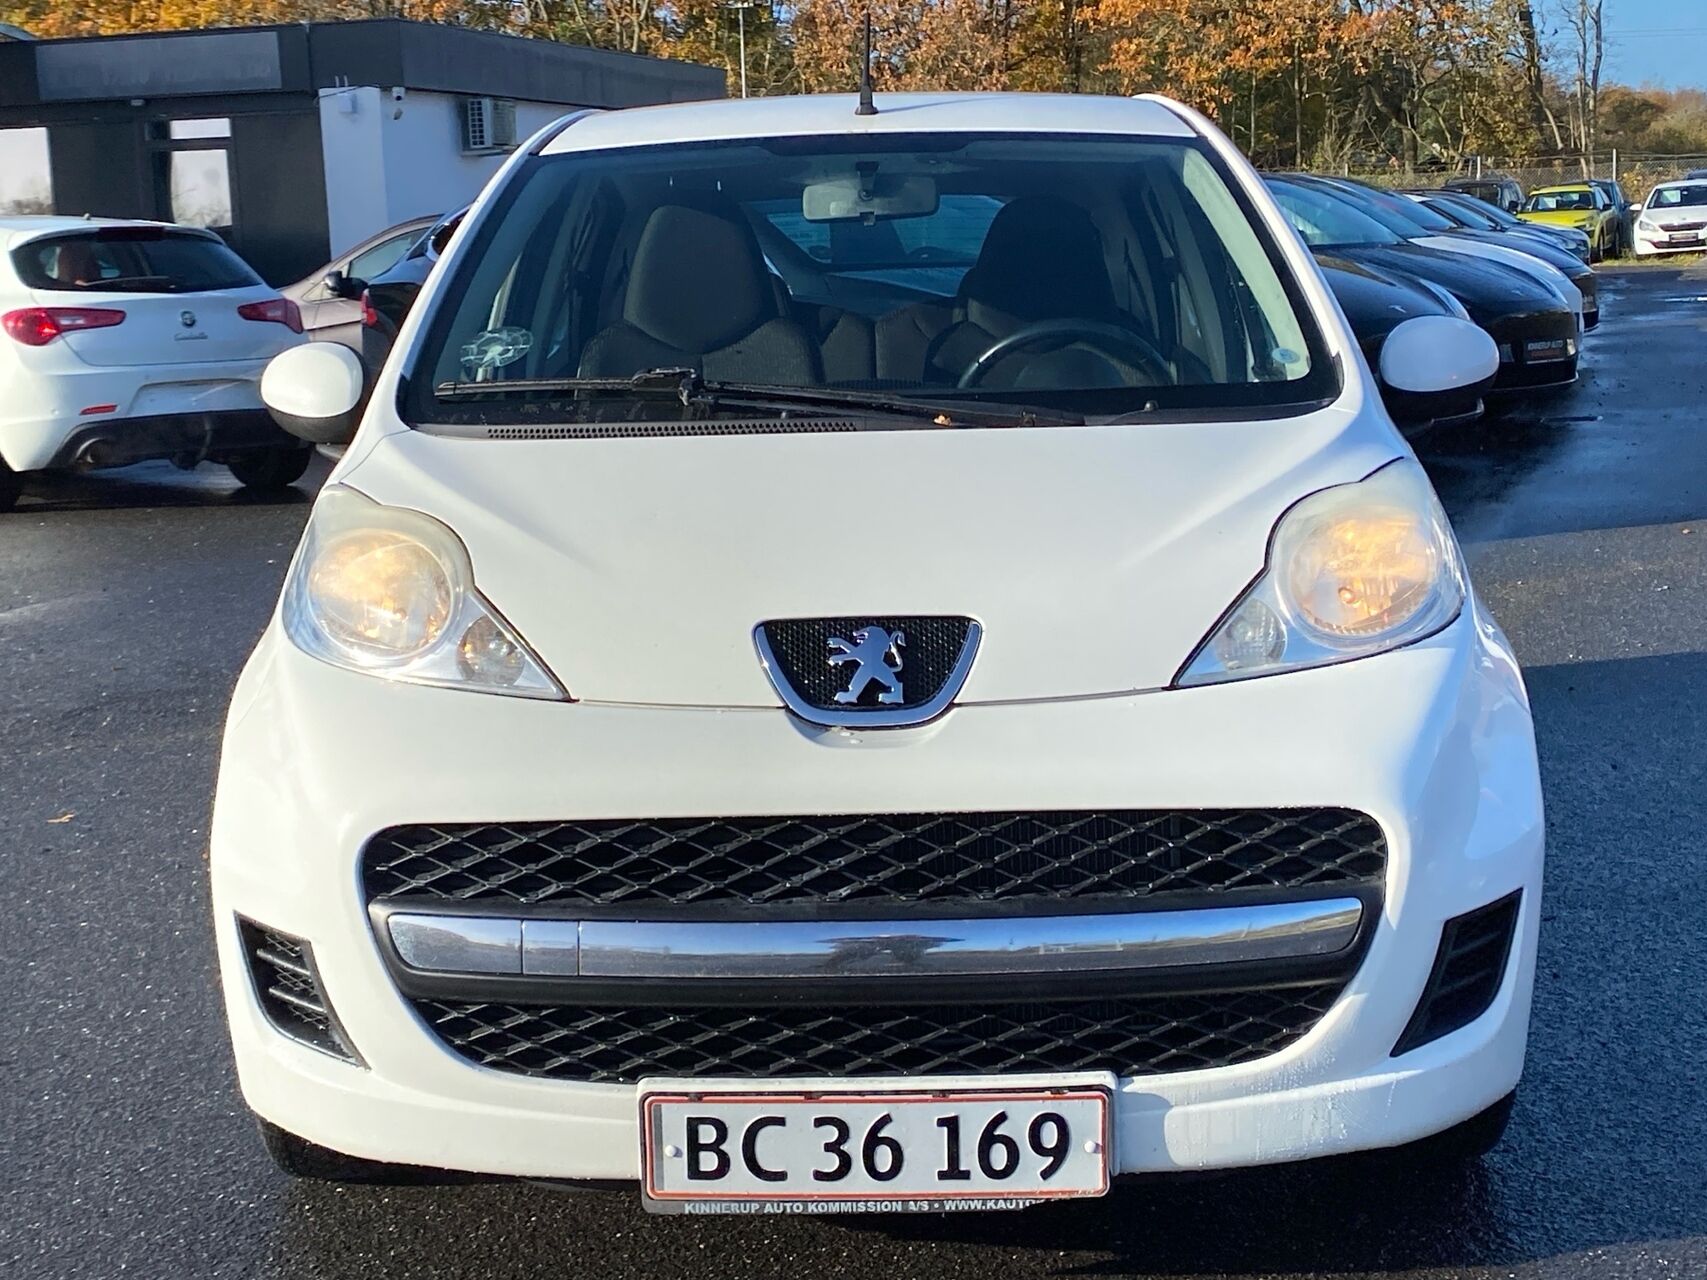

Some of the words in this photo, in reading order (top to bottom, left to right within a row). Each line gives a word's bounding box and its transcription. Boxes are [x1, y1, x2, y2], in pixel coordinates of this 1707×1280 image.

[685, 1115, 788, 1182] BC
[811, 1111, 905, 1182] 36
[936, 1110, 1073, 1182] 169
[684, 1201, 760, 1214] KINNERUP
[763, 1200, 804, 1214] AUTO
[807, 1200, 902, 1213] KOMMISSION
